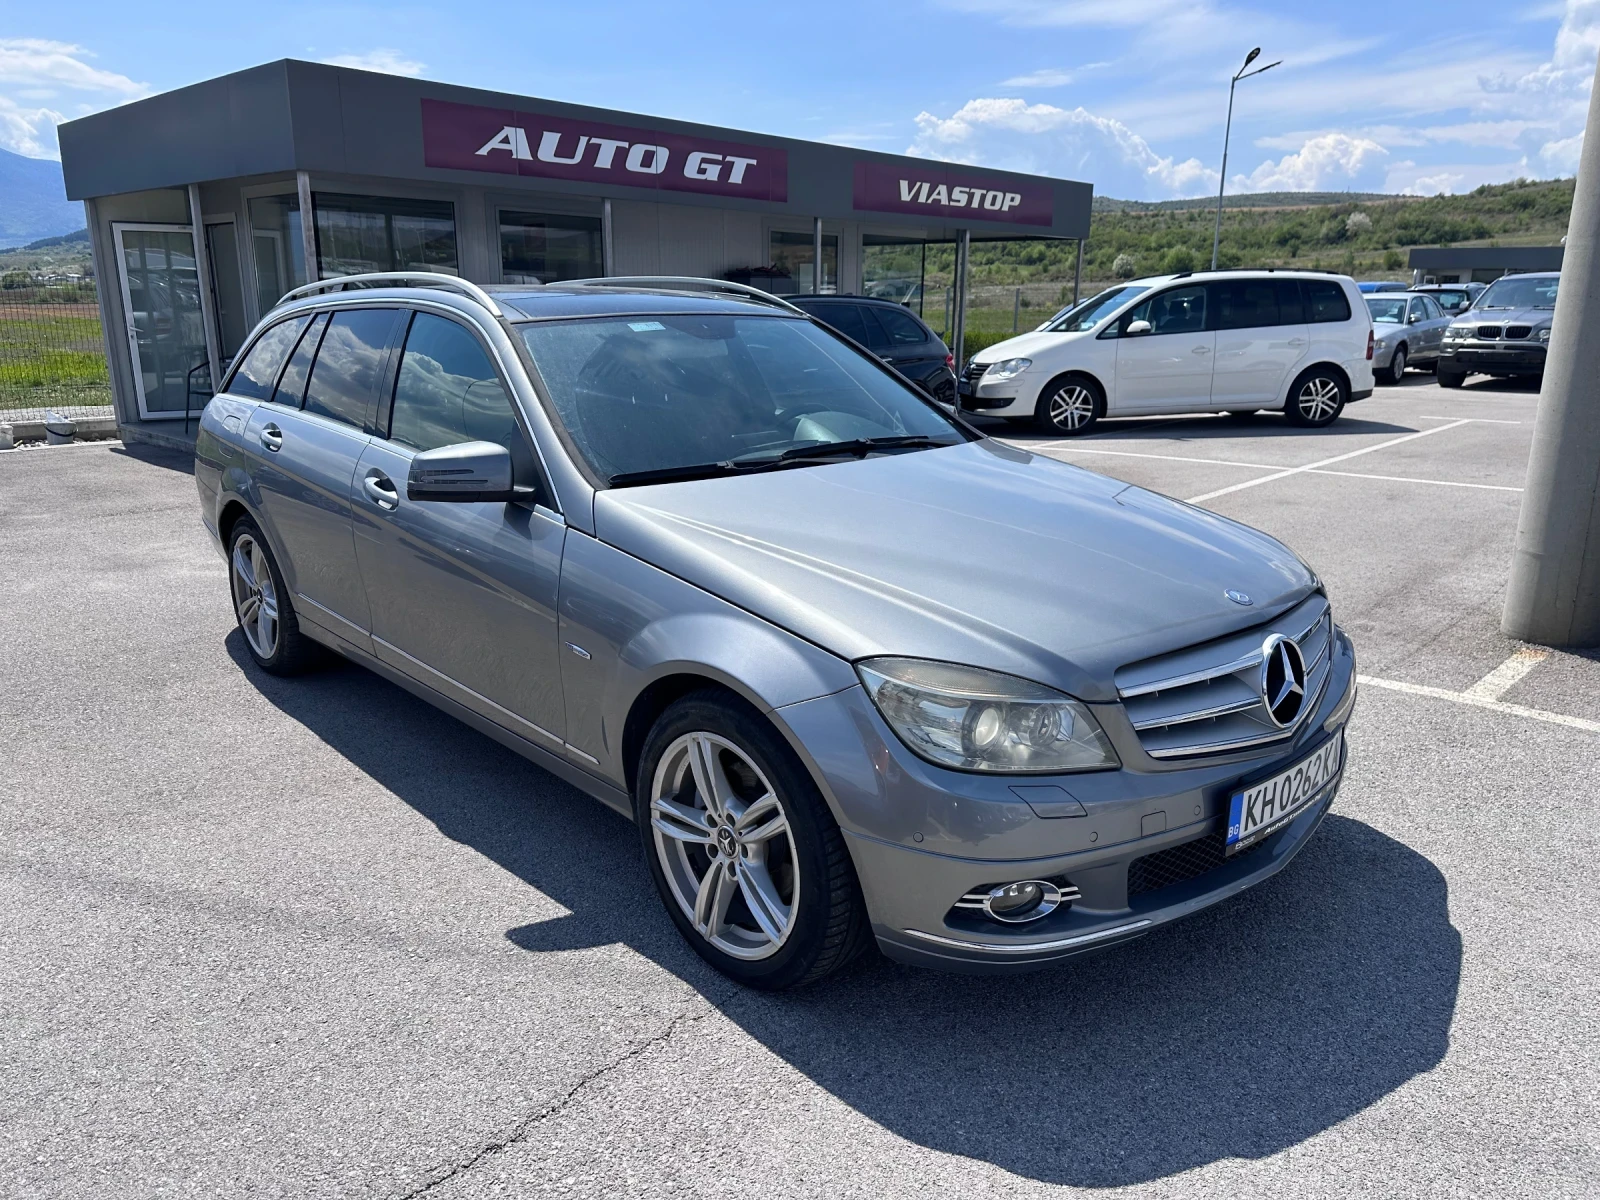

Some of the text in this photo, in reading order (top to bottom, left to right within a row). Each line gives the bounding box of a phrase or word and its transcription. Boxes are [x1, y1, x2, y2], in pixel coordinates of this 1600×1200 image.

[475, 126, 757, 184] AUTO GT
[899, 180, 1021, 211] VIASTOP
[1228, 824, 1240, 838] BG
